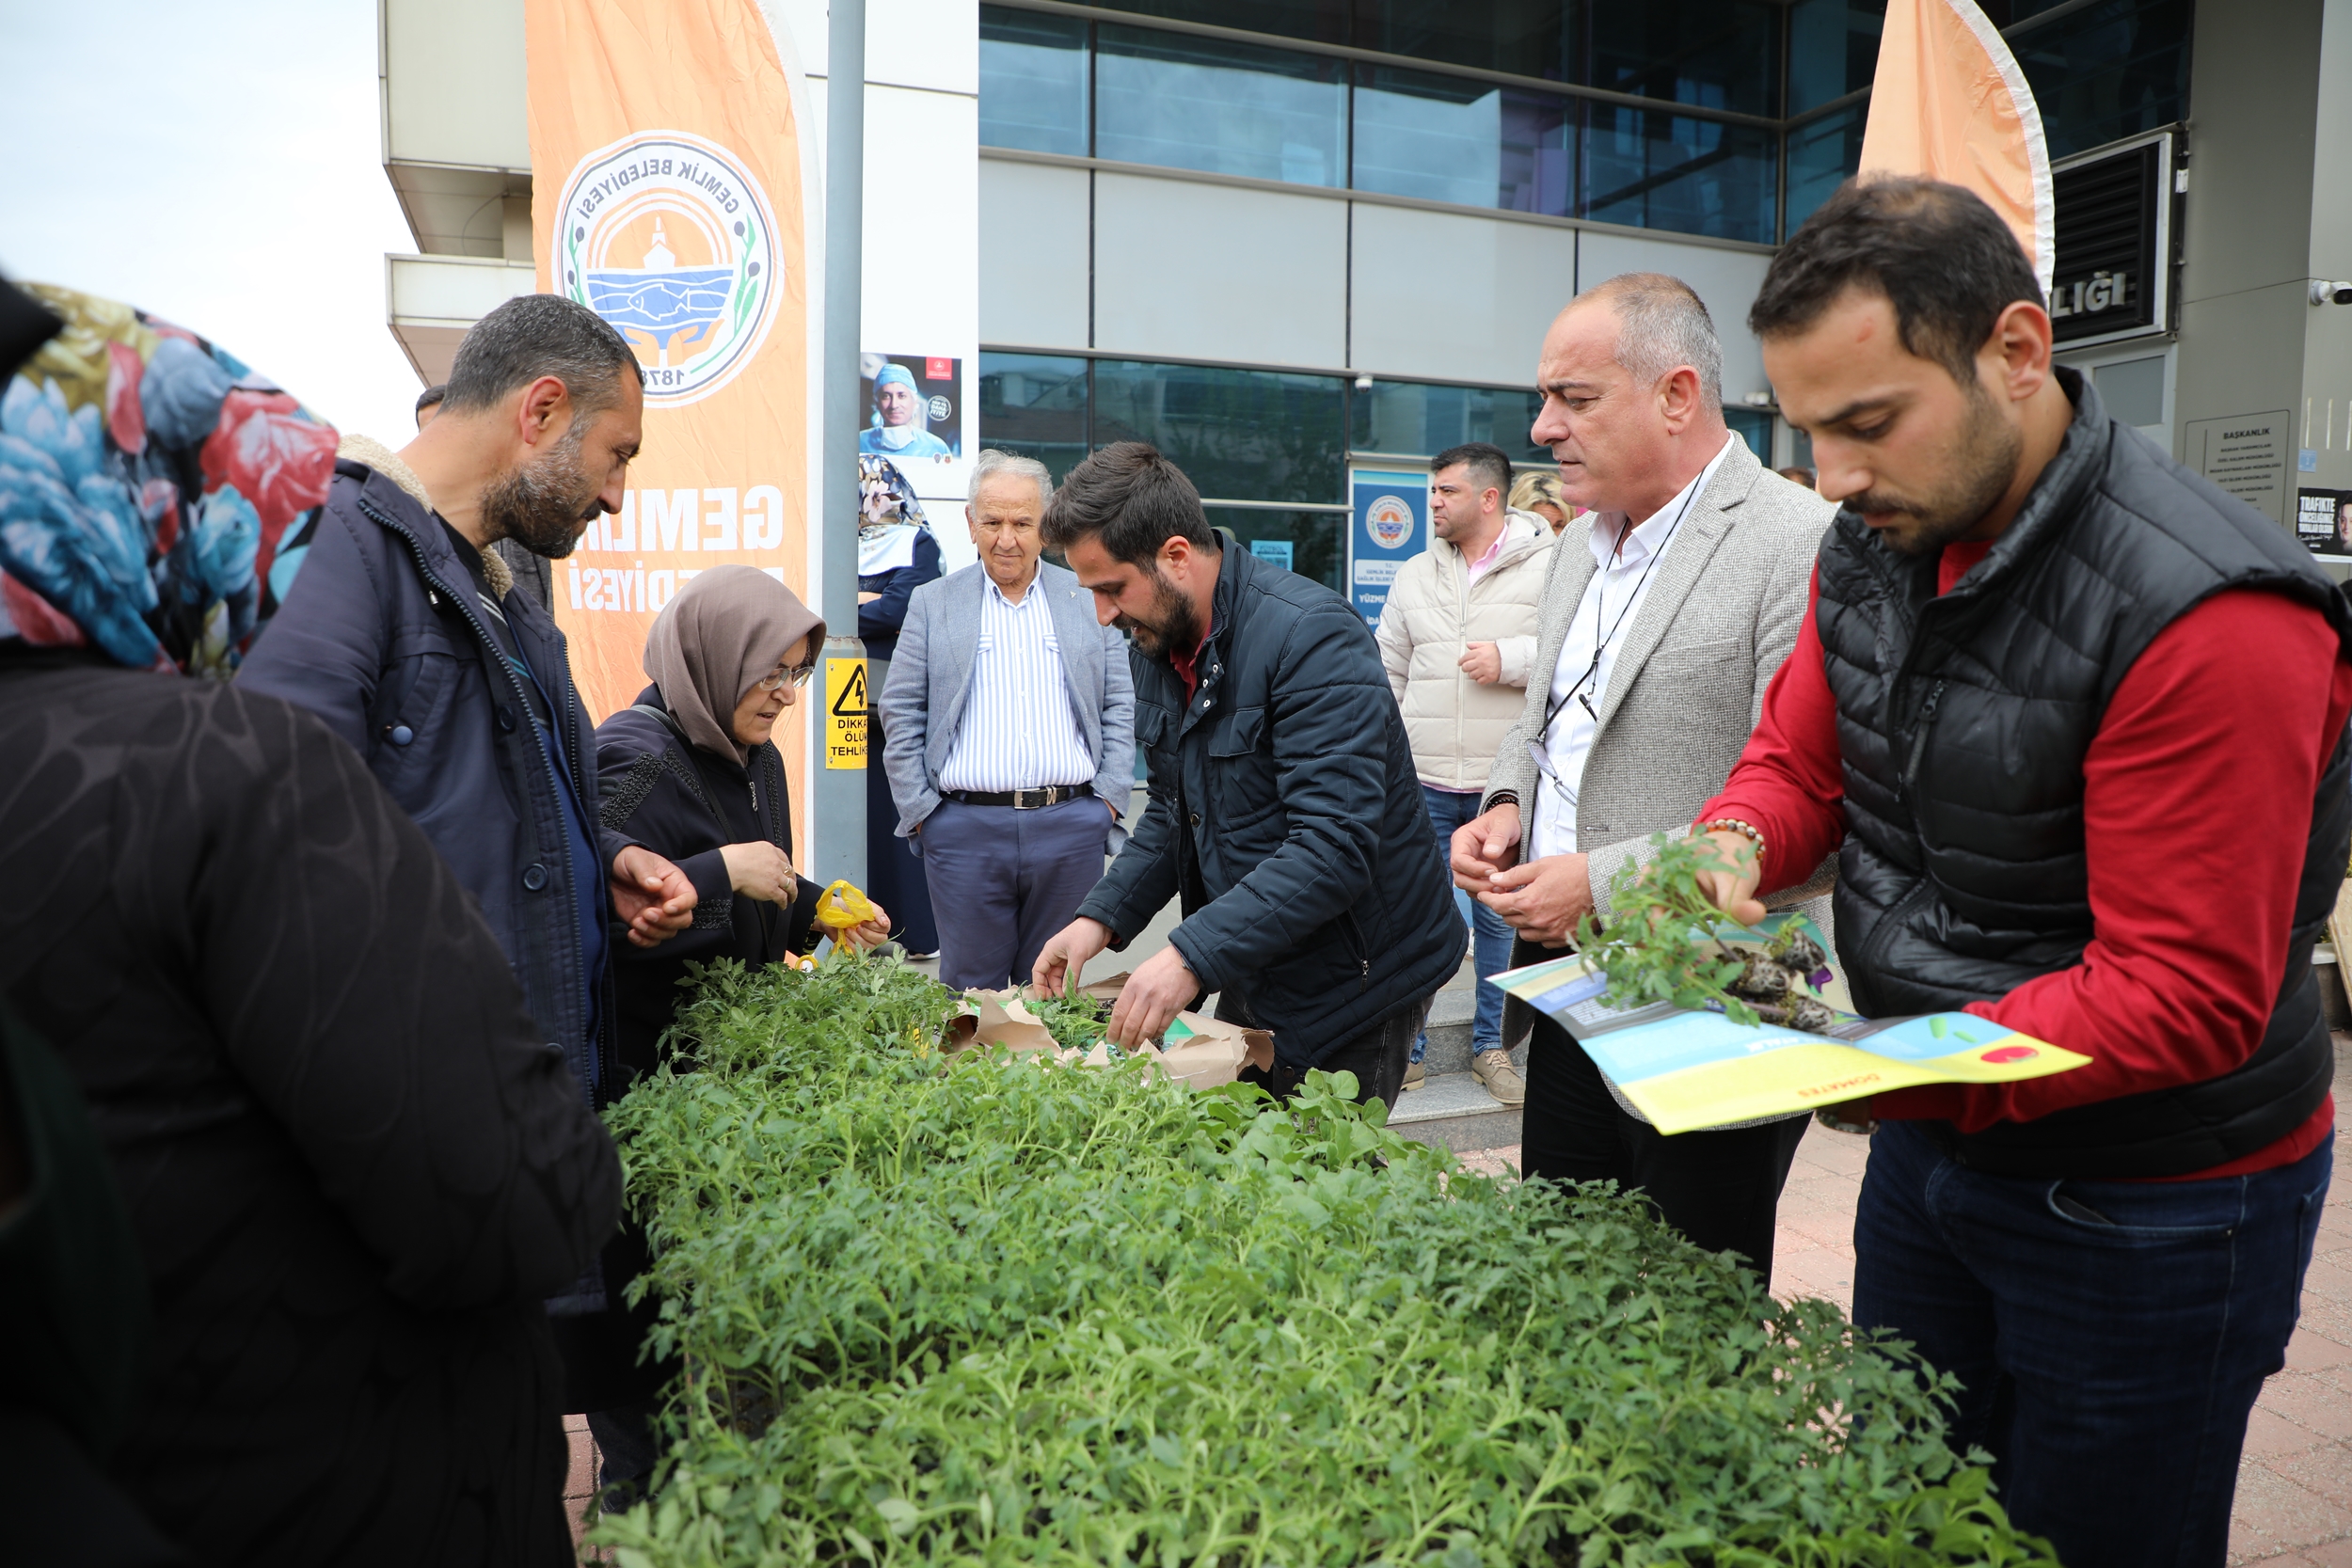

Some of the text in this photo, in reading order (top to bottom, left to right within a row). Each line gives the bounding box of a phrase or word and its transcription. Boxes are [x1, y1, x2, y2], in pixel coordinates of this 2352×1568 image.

[2223, 427, 2271, 440] BAŞKANLIK
[1359, 593, 1386, 603] YÜZME
[838, 717, 867, 729] DİKKA
[1798, 1073, 1881, 1098] DOMATES
